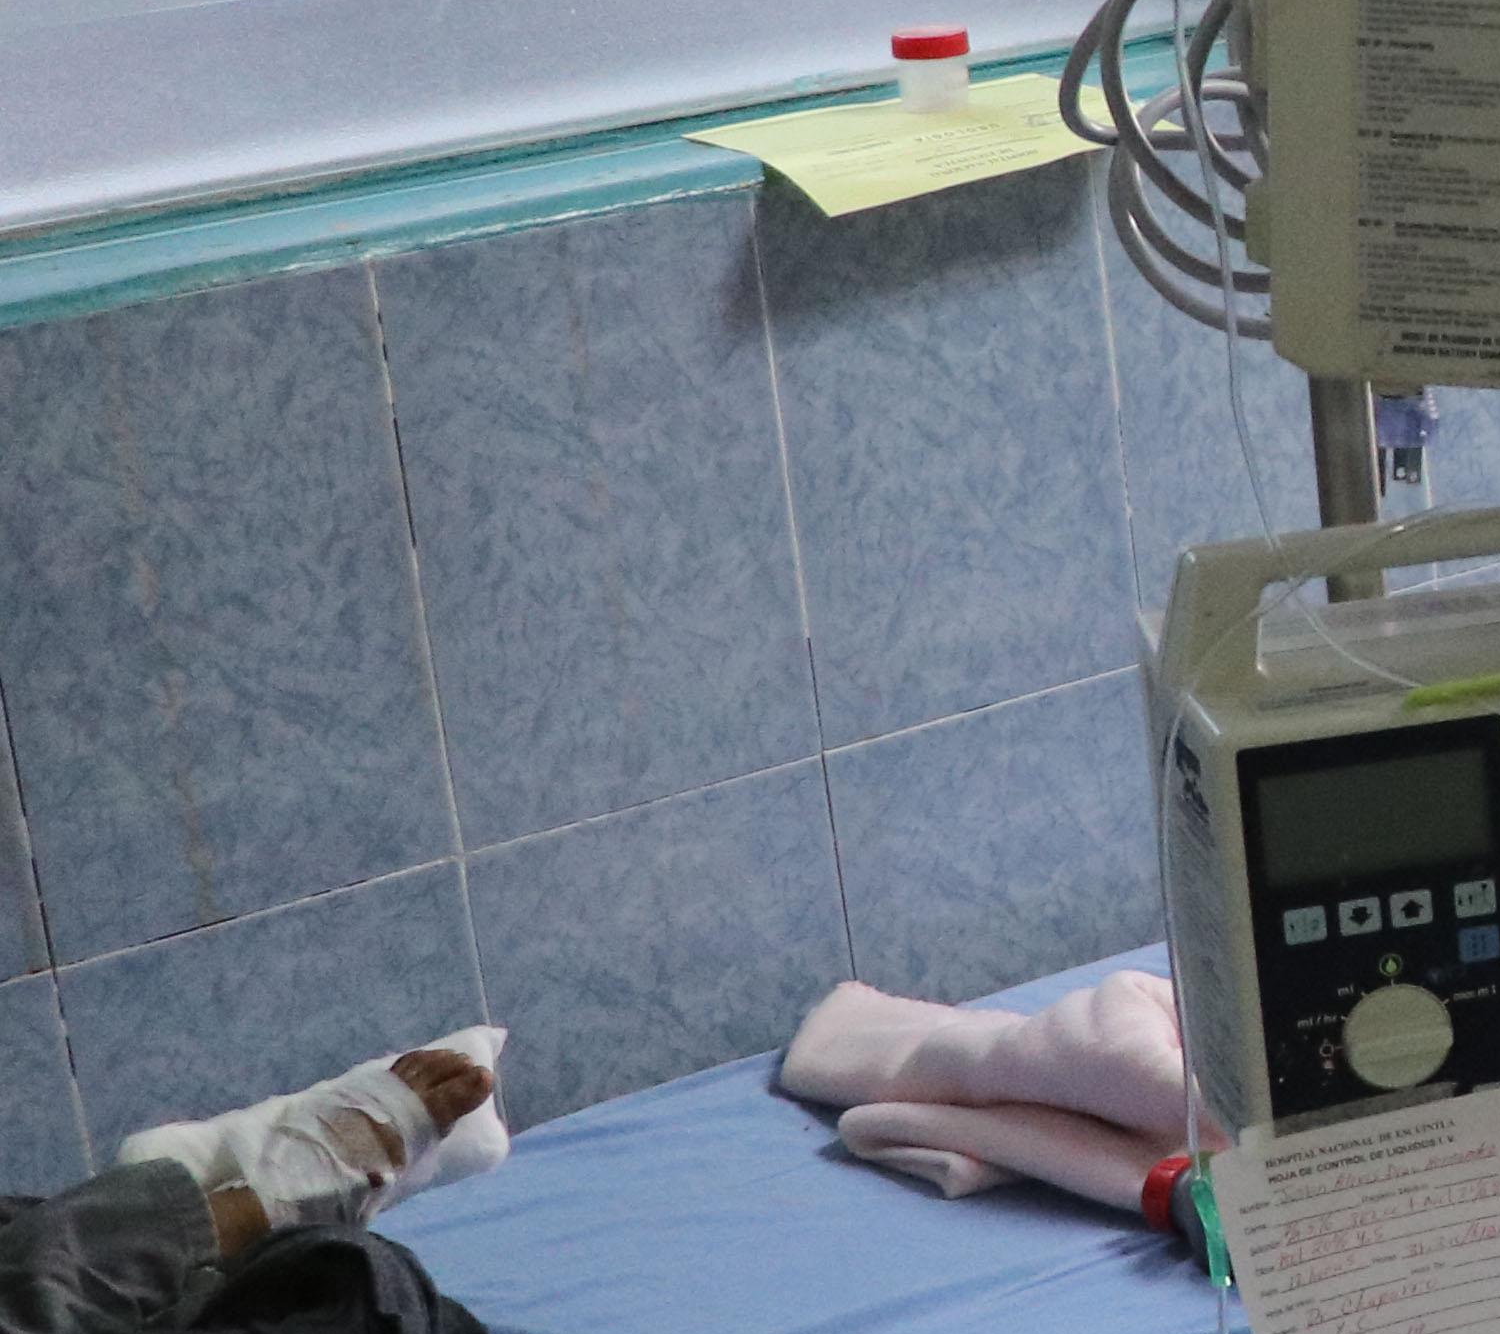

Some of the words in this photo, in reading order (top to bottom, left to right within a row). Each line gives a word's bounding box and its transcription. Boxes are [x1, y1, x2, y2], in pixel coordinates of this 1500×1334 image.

[1265, 1149, 1318, 1170] HOSPITAL
[1318, 1136, 1374, 1160] NACIONAL
[1378, 1132, 1393, 1144] DE
[1267, 1169, 1298, 1186] HOJA
[1299, 1165, 1313, 1177] DE
[1315, 1155, 1369, 1174] CONTROL
[1369, 1149, 1386, 1160] DE
